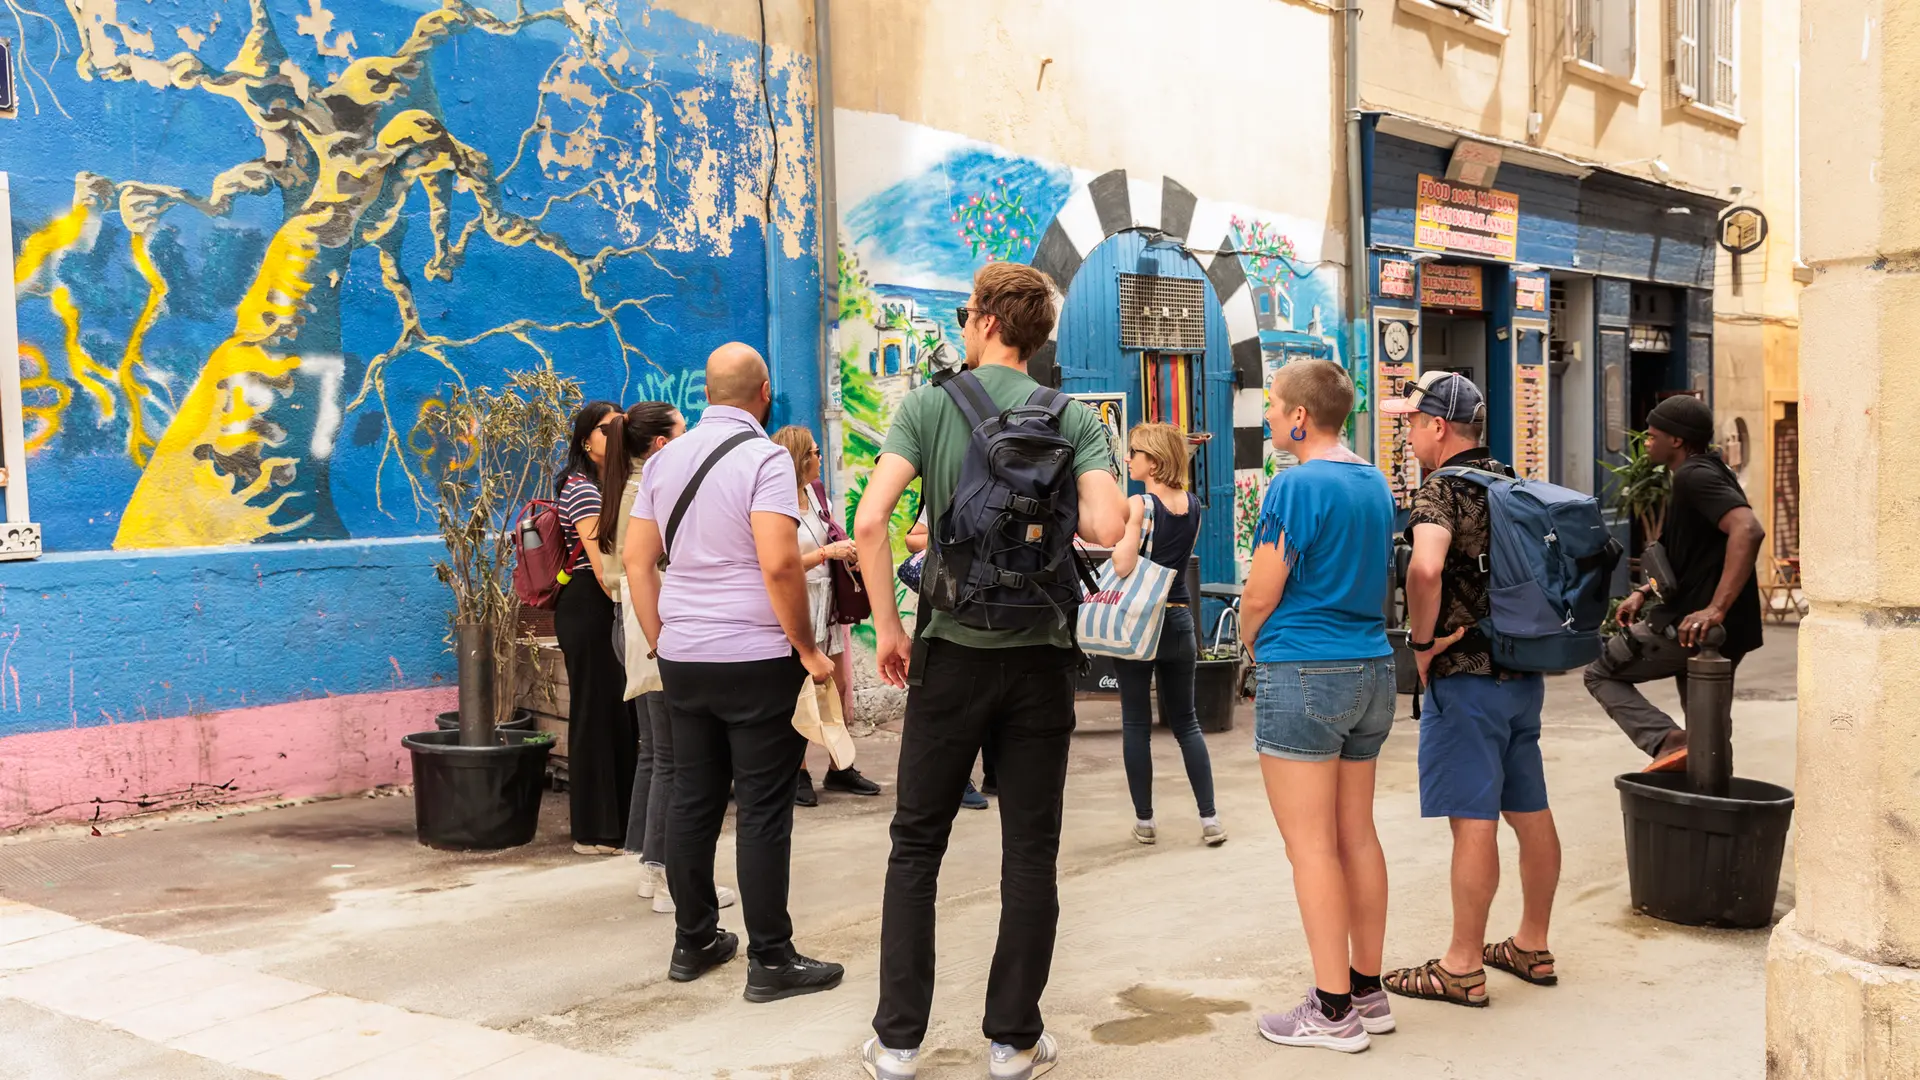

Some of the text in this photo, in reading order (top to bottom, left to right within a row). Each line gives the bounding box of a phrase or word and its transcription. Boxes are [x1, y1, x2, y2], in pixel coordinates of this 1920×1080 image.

[1420, 181, 1516, 214] FOOD 100% MAISON
[1420, 204, 1430, 219] LE
[1384, 263, 1410, 278] SNACK
[1423, 277, 1471, 292] BIENVENUS
[1429, 291, 1455, 305] Grande
